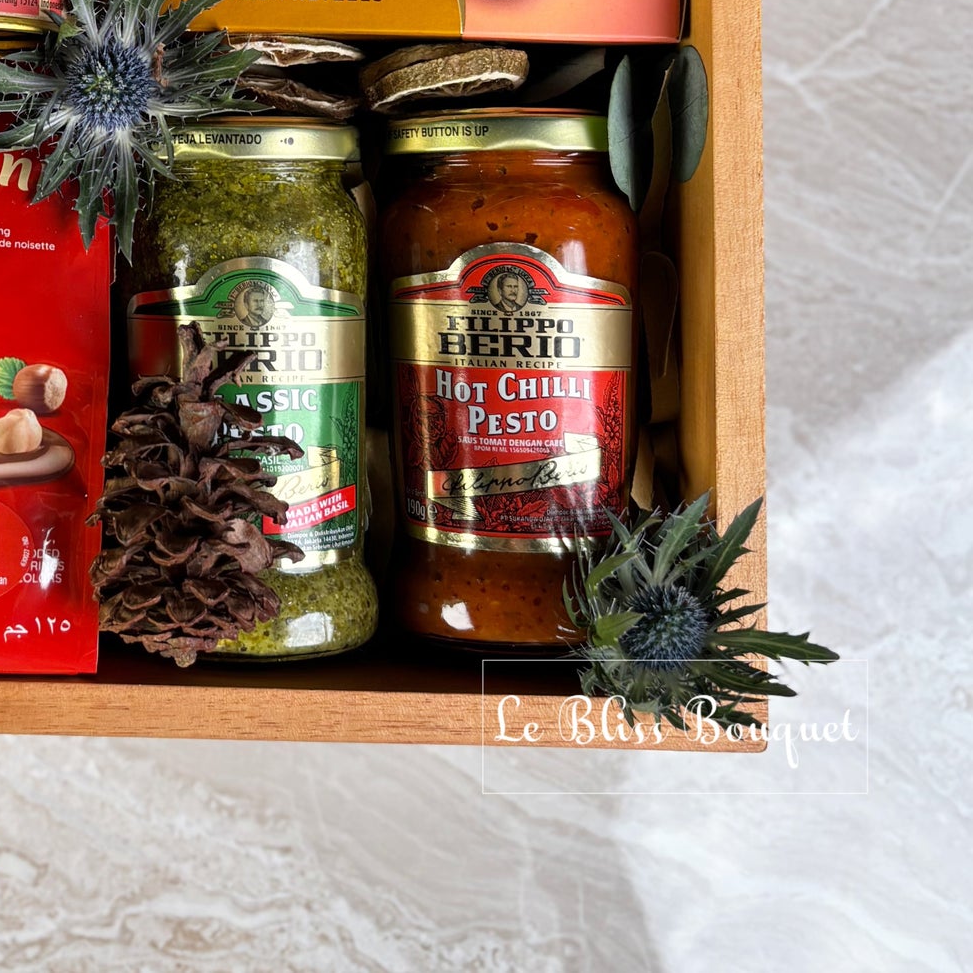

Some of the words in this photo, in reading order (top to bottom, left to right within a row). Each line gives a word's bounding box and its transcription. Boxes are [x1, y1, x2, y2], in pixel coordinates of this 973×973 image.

[199, 134, 262, 145] LEVANTADO
[393, 128, 419, 139] SAFETY
[421, 126, 459, 137] BUTTON
[474, 126, 489, 136] UP
[14, 240, 56, 251] noisette
[471, 309, 498, 317] SINCE
[447, 315, 574, 334] FILIPPO
[203, 331, 316, 348] ILIPPO
[438, 332, 581, 359] BERIO
[454, 357, 507, 368] ITALIAN
[516, 360, 562, 369] RECIPE
[214, 388, 318, 413] ASSIC
[457, 435, 477, 444] SAUS
[479, 437, 507, 446] TOMAT
[509, 438, 542, 447] DENGAN
[285, 502, 317, 519] MADE
[319, 493, 342, 508] WITH
[324, 500, 349, 516] BASIL
